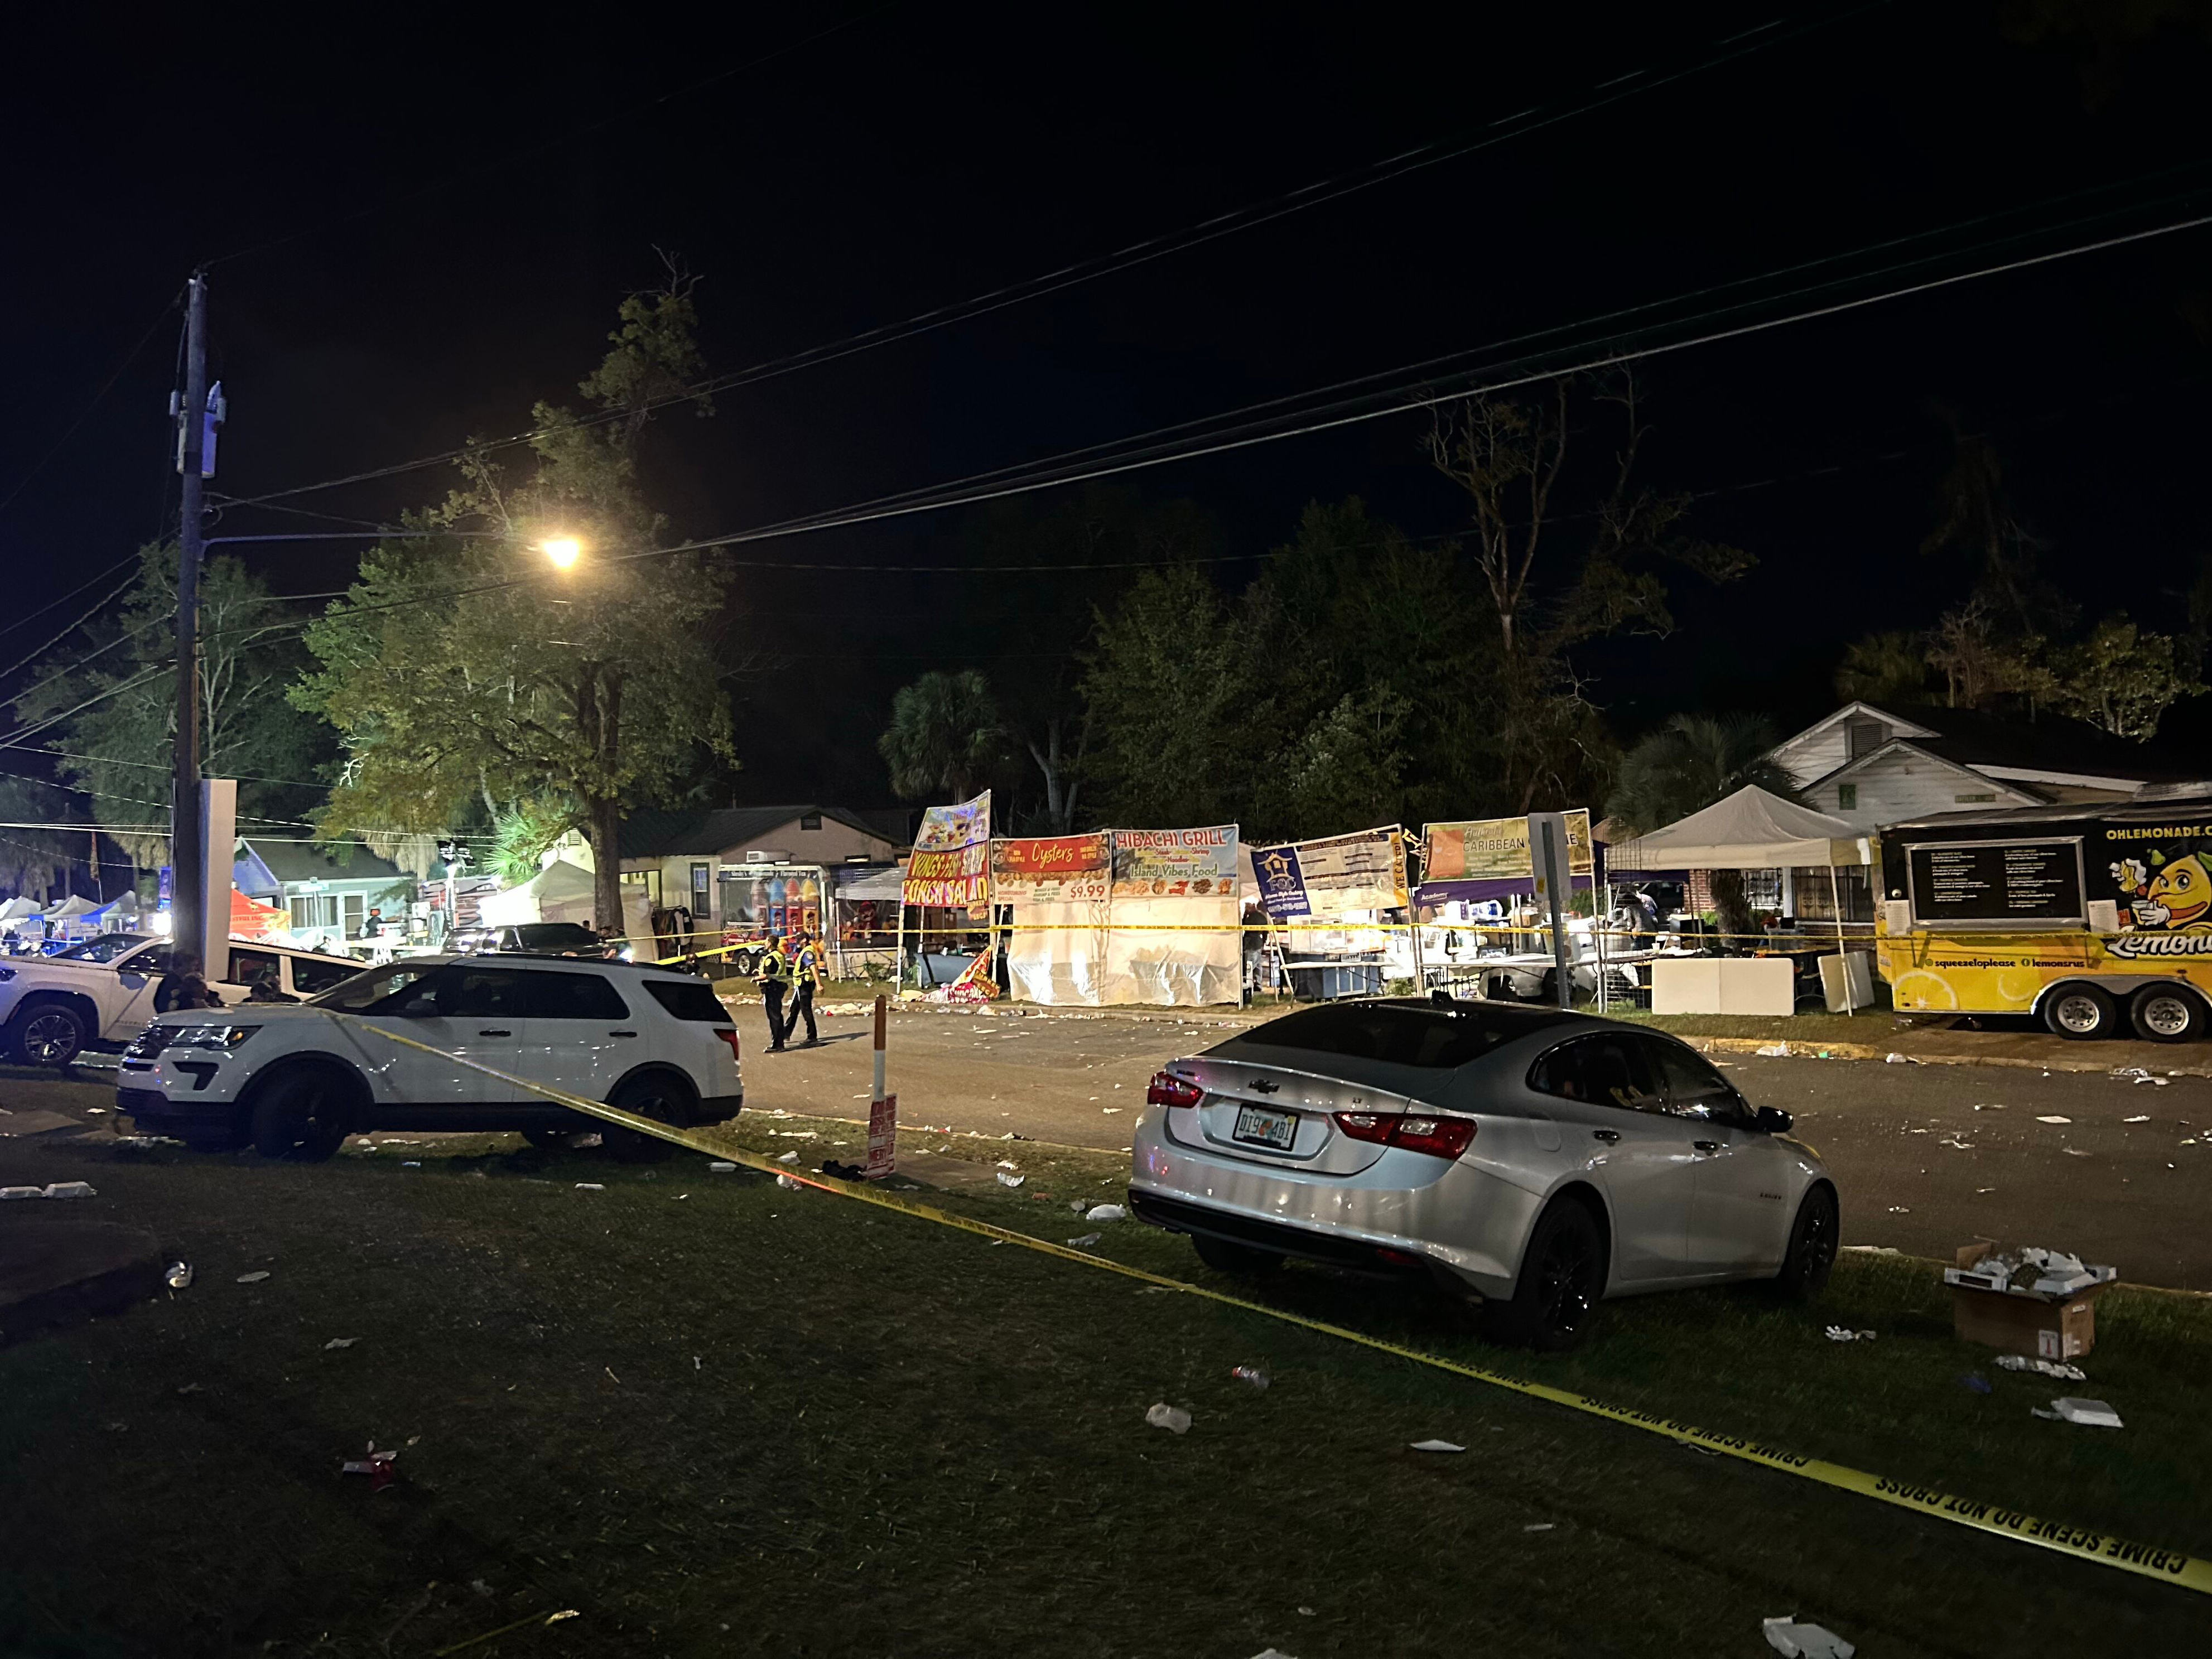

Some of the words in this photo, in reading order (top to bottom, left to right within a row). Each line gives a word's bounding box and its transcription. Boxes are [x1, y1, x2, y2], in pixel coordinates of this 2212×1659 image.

[1116, 831, 1179, 847] HIBACHI
[1182, 829, 1227, 846] GRILL
[1463, 838, 1525, 852] CARIBBEAN
[1032, 842, 1074, 869] Oysters
[1130, 865, 1159, 877] Island
[1162, 864, 1188, 876] Vibes
[1192, 863, 1218, 876] Food
[945, 877, 988, 905] SALAD
[1071, 885, 1105, 898] $9.99
[1875, 1477, 1945, 1506] CROSS
[1944, 1497, 1990, 1520] NOT
[1993, 1511, 2027, 1530] DO
[2028, 1522, 2102, 1552] SCENE
[2107, 1542, 2187, 1574] CRIME
